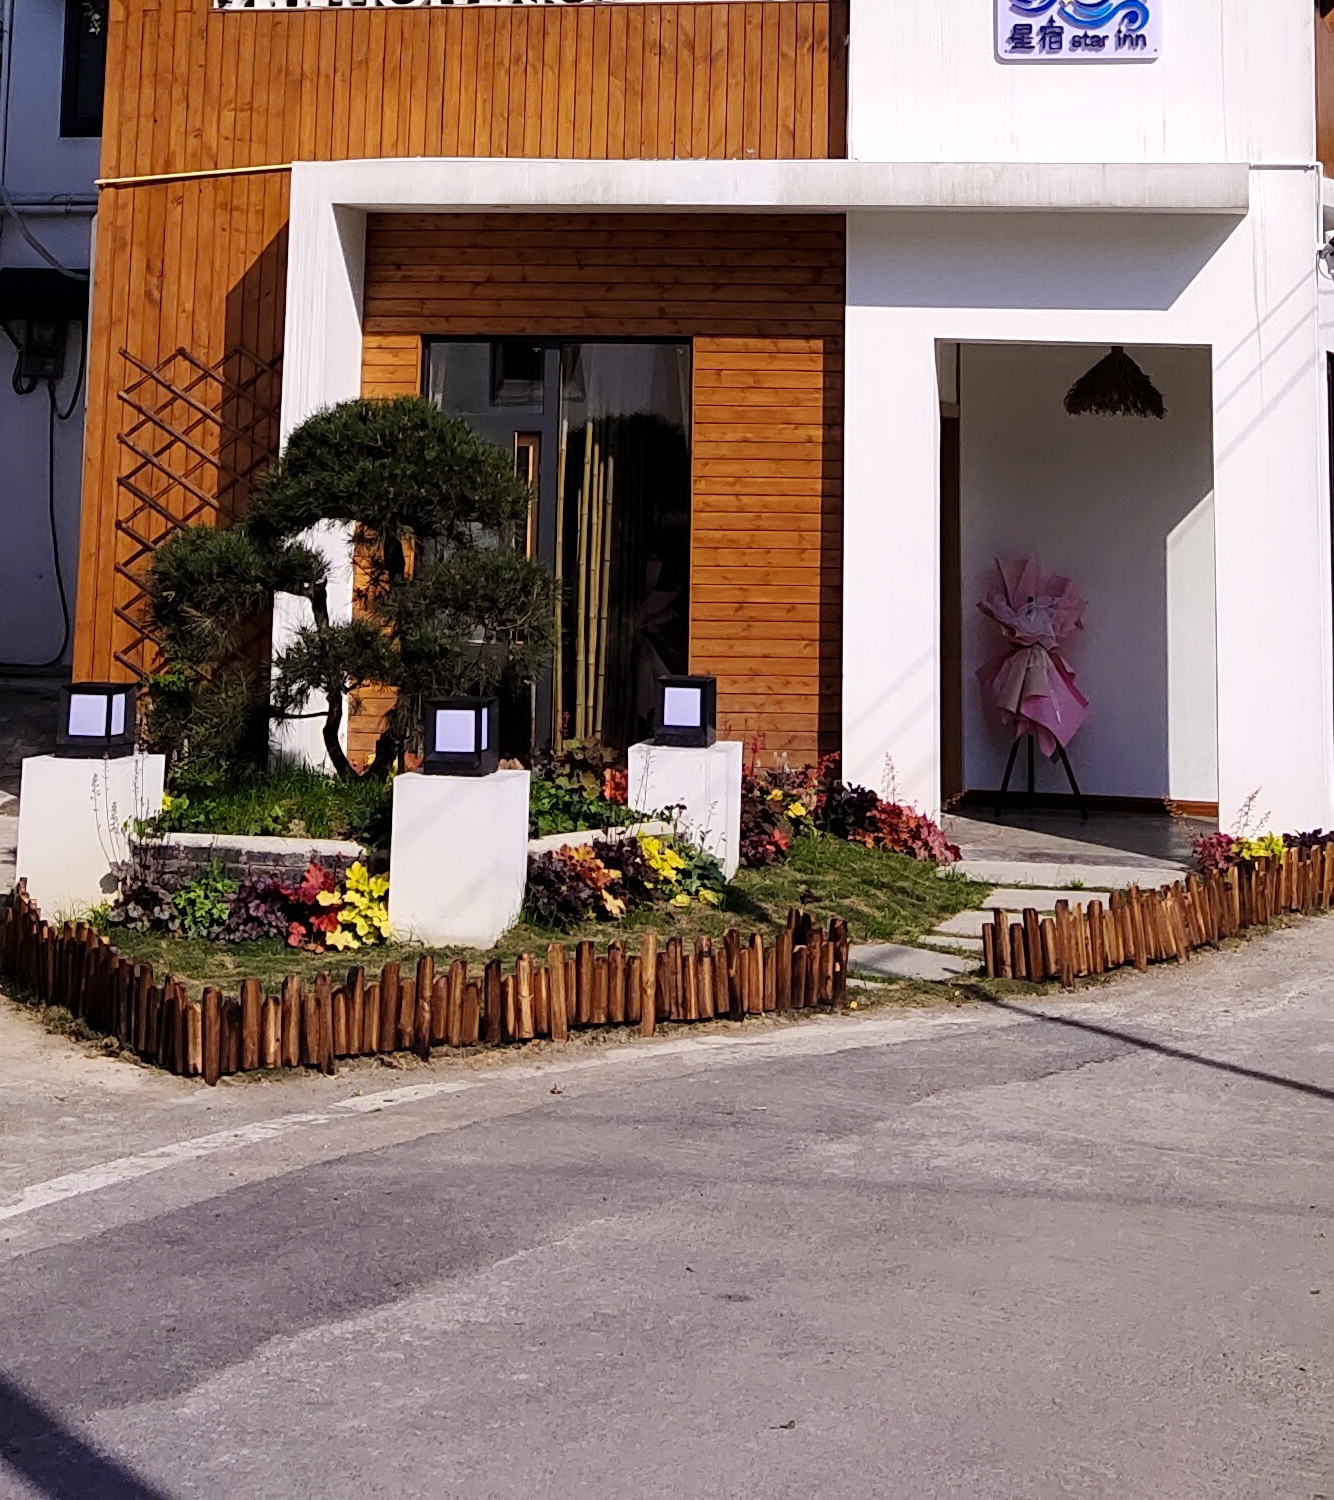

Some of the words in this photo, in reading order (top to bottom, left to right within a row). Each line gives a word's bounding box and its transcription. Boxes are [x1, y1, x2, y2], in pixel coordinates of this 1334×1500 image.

[1008, 15, 1064, 51] 星宿
[1071, 31, 1109, 49] star
[1117, 28, 1147, 49] inn
